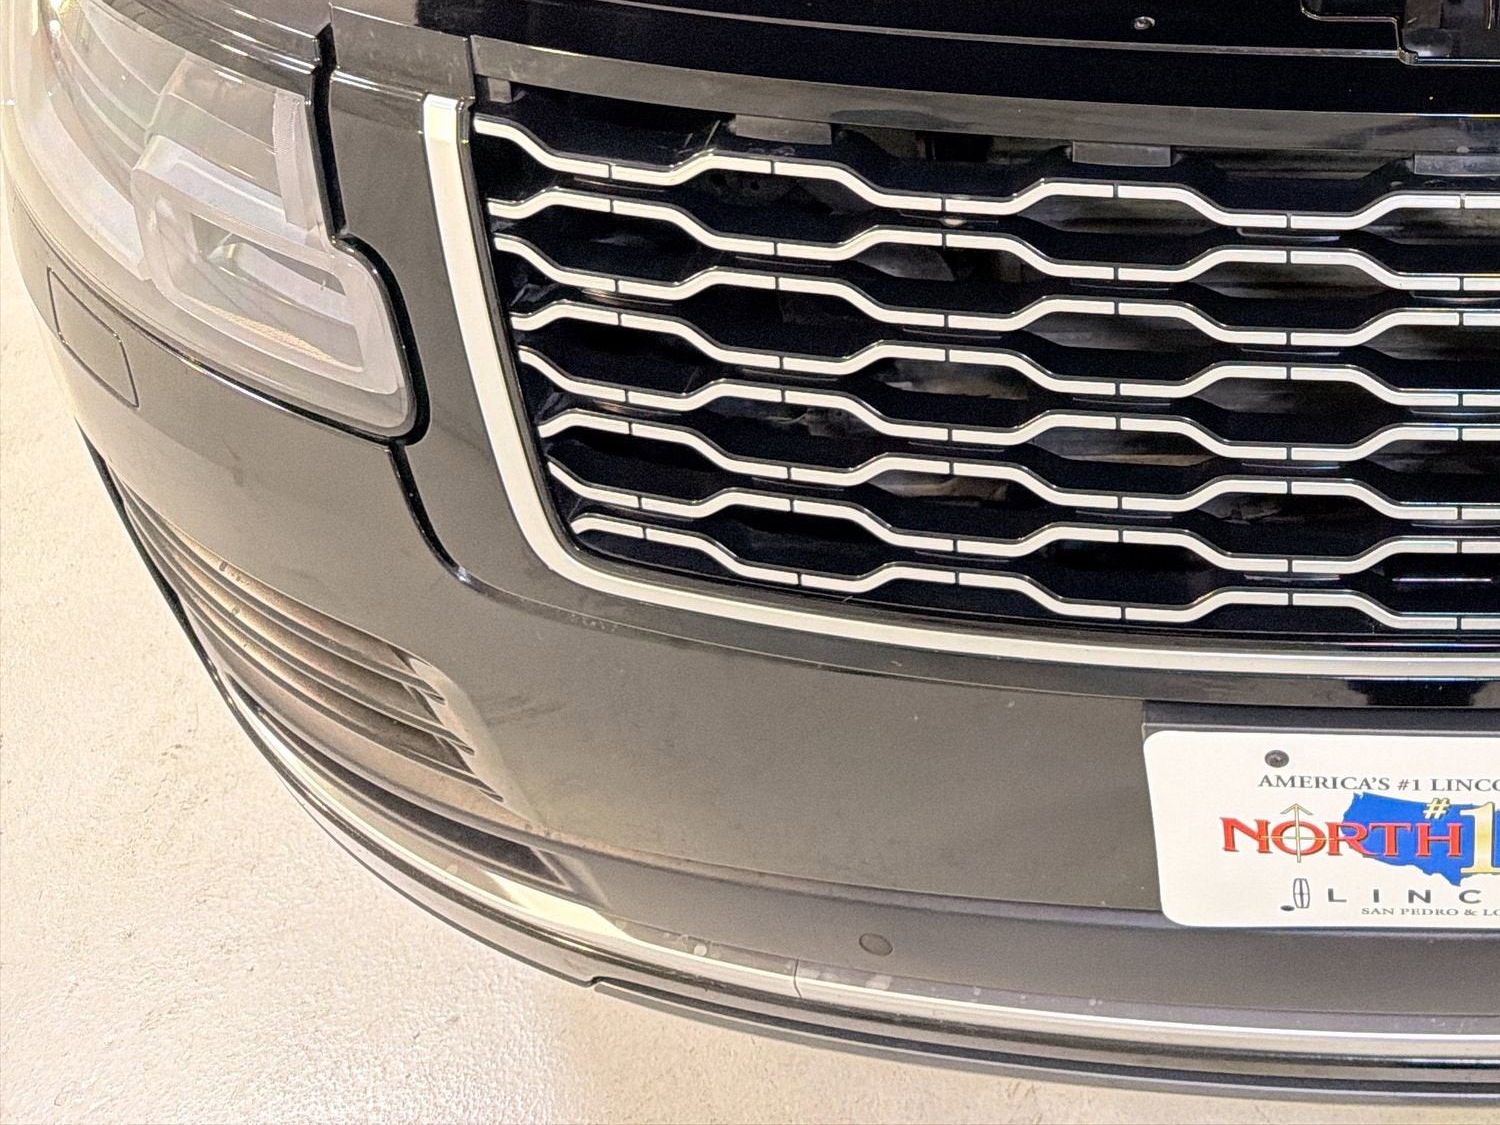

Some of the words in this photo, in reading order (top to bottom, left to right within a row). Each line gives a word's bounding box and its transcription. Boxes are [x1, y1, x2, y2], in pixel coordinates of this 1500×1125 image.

[1258, 774, 1390, 791] AMERICA'S
[1397, 778, 1422, 791] #1
[1219, 817, 1464, 859] NORTH
[1361, 907, 1395, 916] SAN
[1400, 907, 1459, 917] PEDRO
[1463, 909, 1479, 917] &
